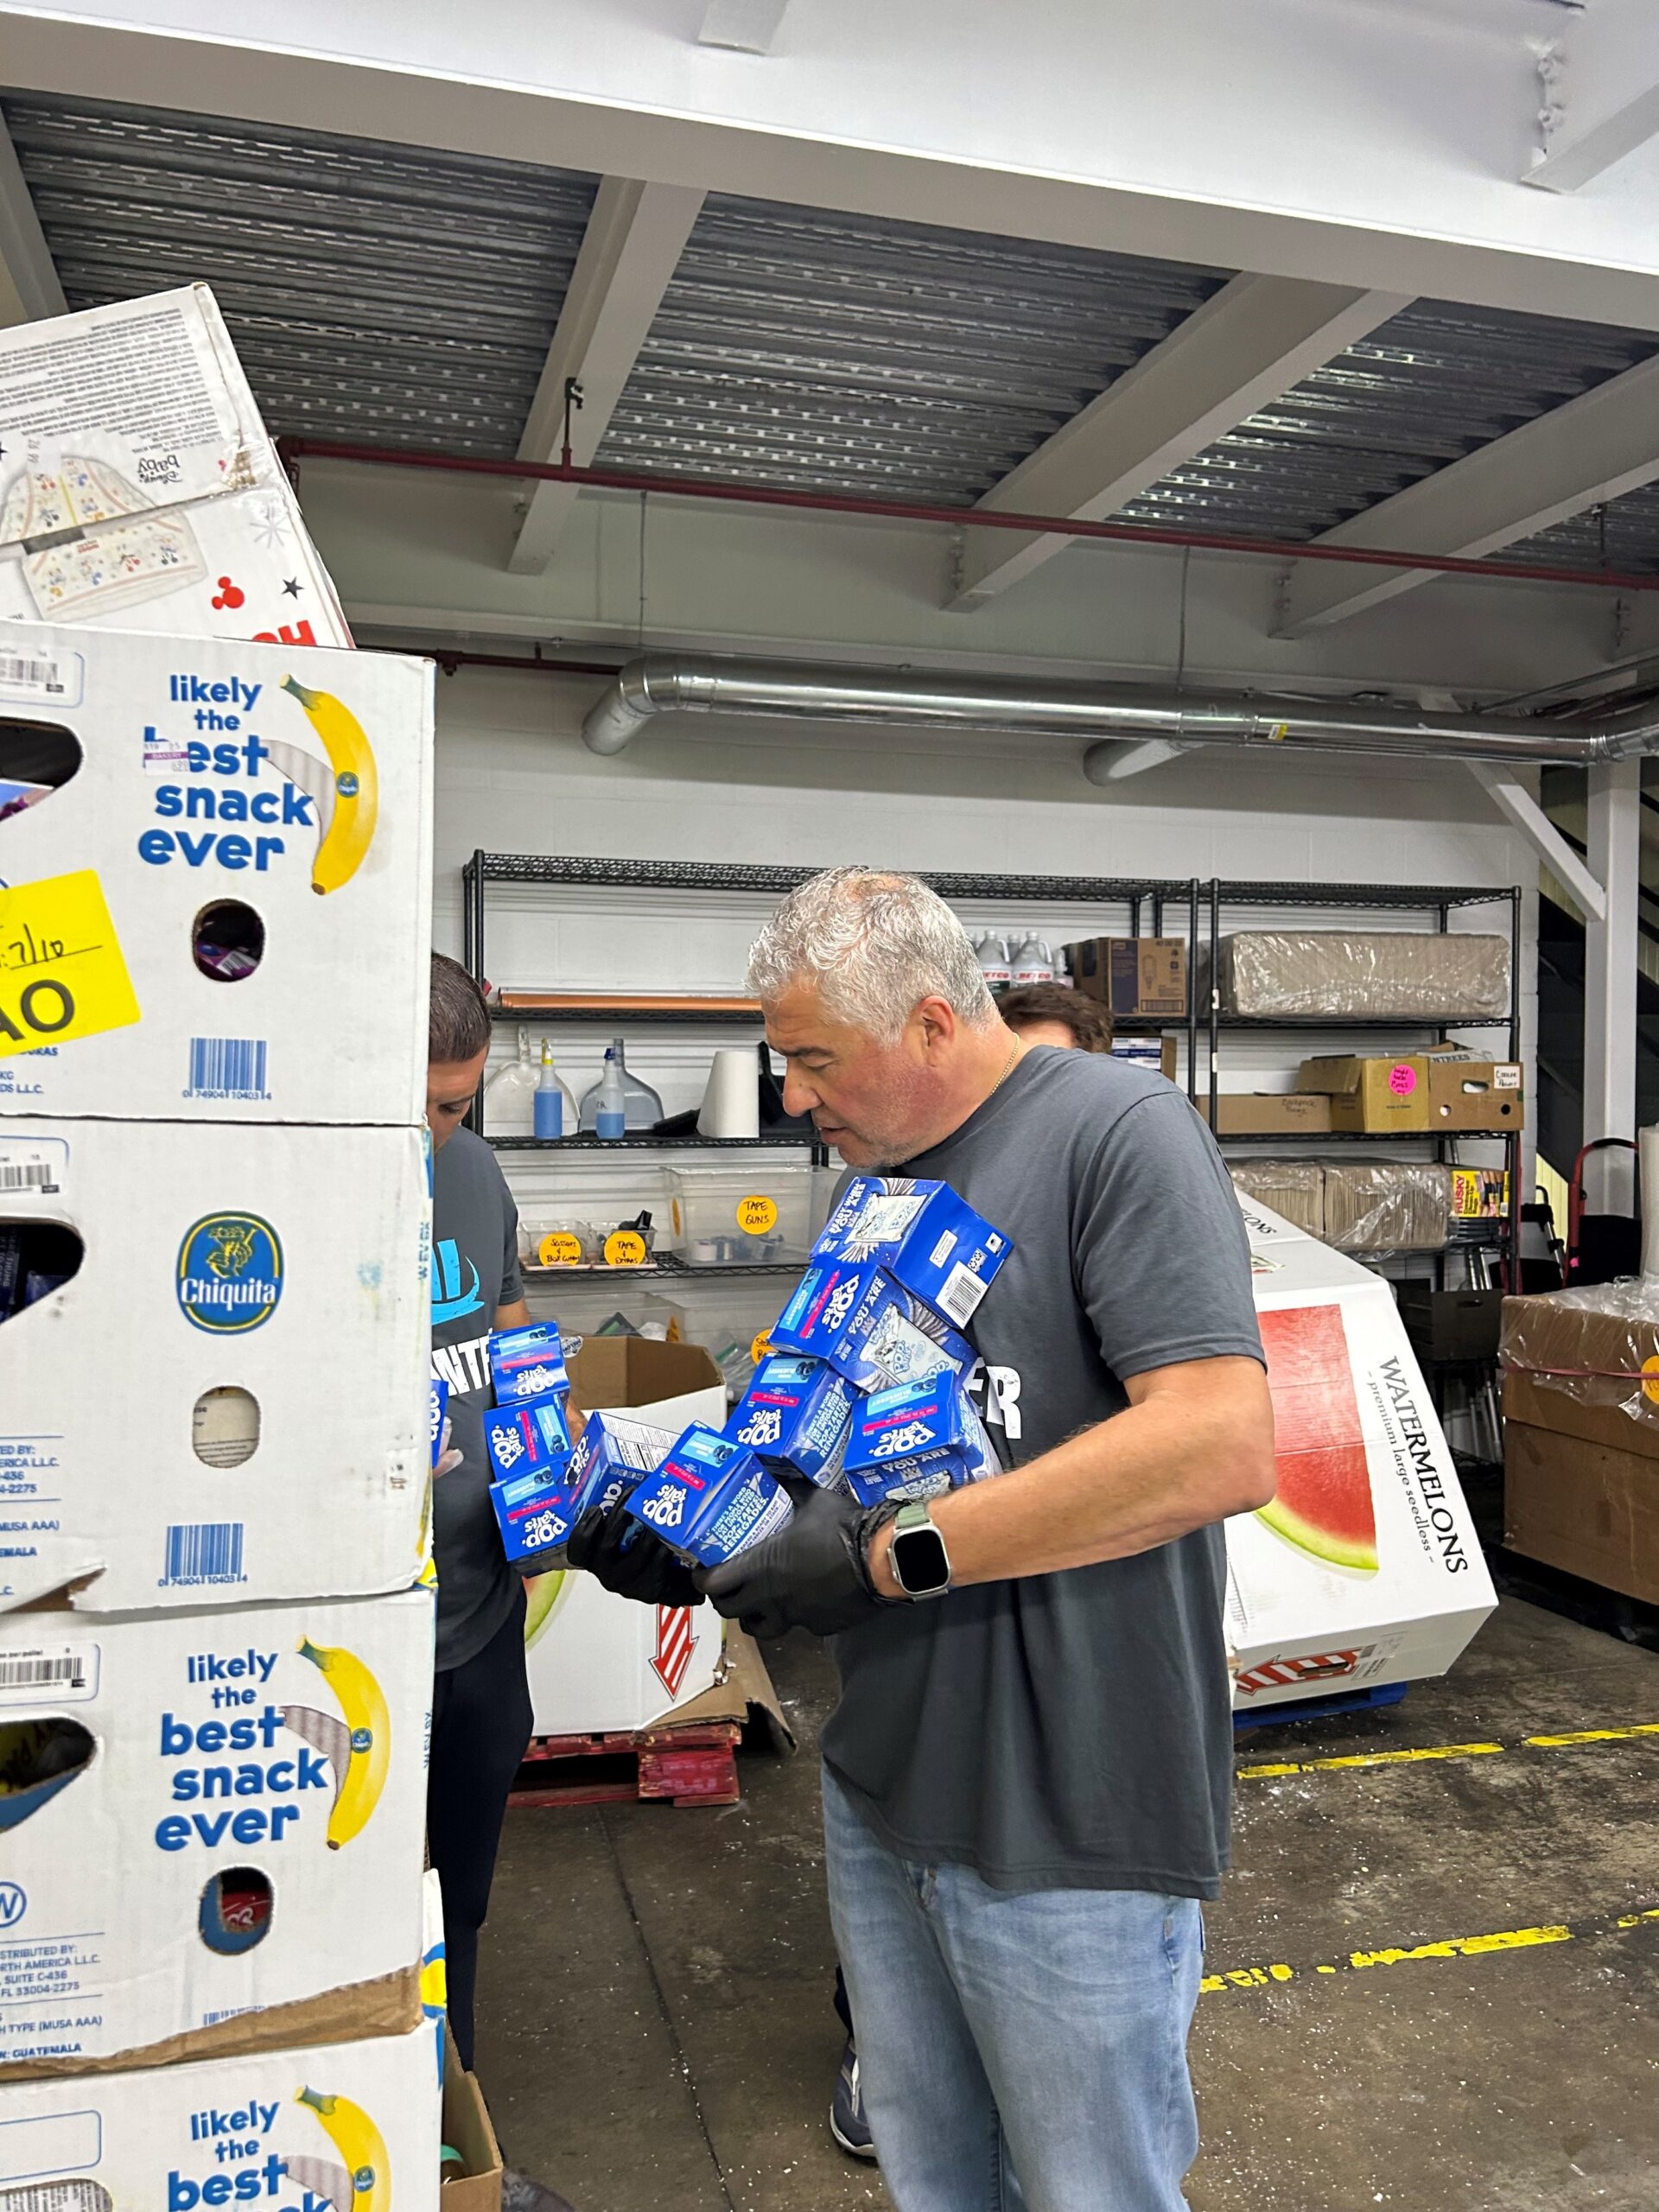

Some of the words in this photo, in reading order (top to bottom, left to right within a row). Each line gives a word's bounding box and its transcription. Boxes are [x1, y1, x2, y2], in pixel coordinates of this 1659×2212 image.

[137, 454, 181, 474] baby
[169, 674, 263, 711] likely
[194, 709, 240, 731] the
[143, 726, 269, 777] est
[155, 782, 314, 826] snack
[138, 829, 285, 871] ever
[743, 1200, 768, 1211] TAPE
[1455, 1174, 1465, 1214] HUSKY
[746, 1214, 769, 1224] GUNS
[617, 1241, 637, 1249] TAPE
[181, 1277, 276, 1312] Chiquita
[849, 1306, 871, 1335] YOU
[867, 1279, 887, 1306] ARE
[818, 1395, 841, 1431] UNTOASTED
[1368, 1381, 1397, 1446] premium
[1393, 1447, 1410, 1487] large
[1406, 1490, 1432, 1552] seedless
[1380, 1355, 1468, 1573] WATERMELONS
[724, 1503, 742, 1524] PEOPLE
[740, 1489, 753, 1504] WHO
[727, 1492, 757, 1528] UNTOASTED
[731, 1487, 747, 1506] WORD
[721, 1497, 769, 1553] RENEGADES.
[188, 1648, 278, 1682] likely
[212, 1686, 257, 1708] the
[161, 1706, 285, 1756] best
[172, 1748, 330, 1801] snack
[156, 1804, 300, 1851] ever
[4, 1973, 35, 1985] SUITE
[24, 1957, 72, 1970] AMERICA
[9, 2022, 35, 2033] TYPE
[12, 2043, 81, 2057] GUATEMALA
[191, 2100, 280, 2140] likely
[215, 2139, 260, 2163] the
[168, 2153, 289, 2212] best
